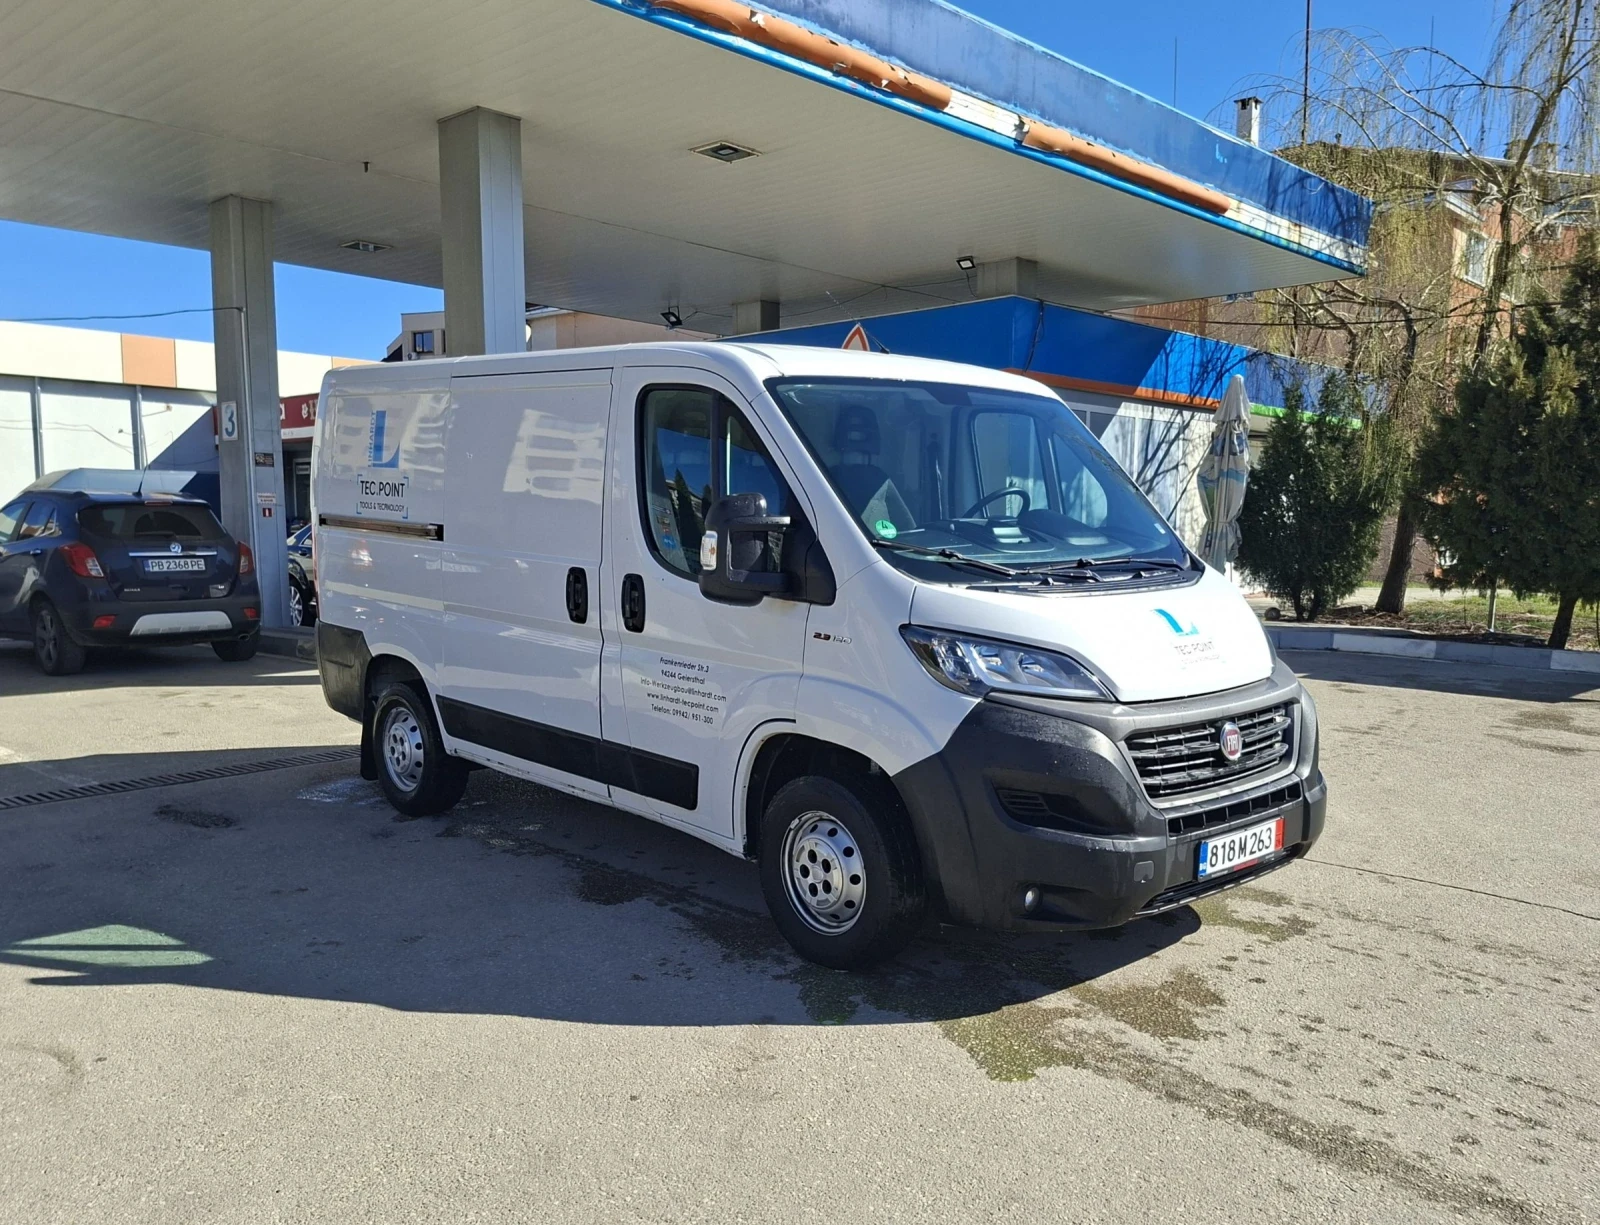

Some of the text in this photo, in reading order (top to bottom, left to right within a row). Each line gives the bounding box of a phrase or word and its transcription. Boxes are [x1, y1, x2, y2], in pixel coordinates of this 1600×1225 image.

[224, 404, 236, 438] 3
[367, 410, 376, 468] LINHARDT
[360, 480, 405, 498] TEC.POINT
[359, 501, 373, 510] TOOLS
[150, 560, 165, 571] PB
[166, 560, 190, 570] 2368
[190, 559, 204, 570] PE
[660, 657, 697, 671] Frankenrieder
[661, 669, 706, 685] 94244 Geiersthal
[647, 692, 719, 713] www.linhardt-tecpoint.com
[651, 703, 671, 715] Telefon:
[1226, 734, 1239, 751] FIAT
